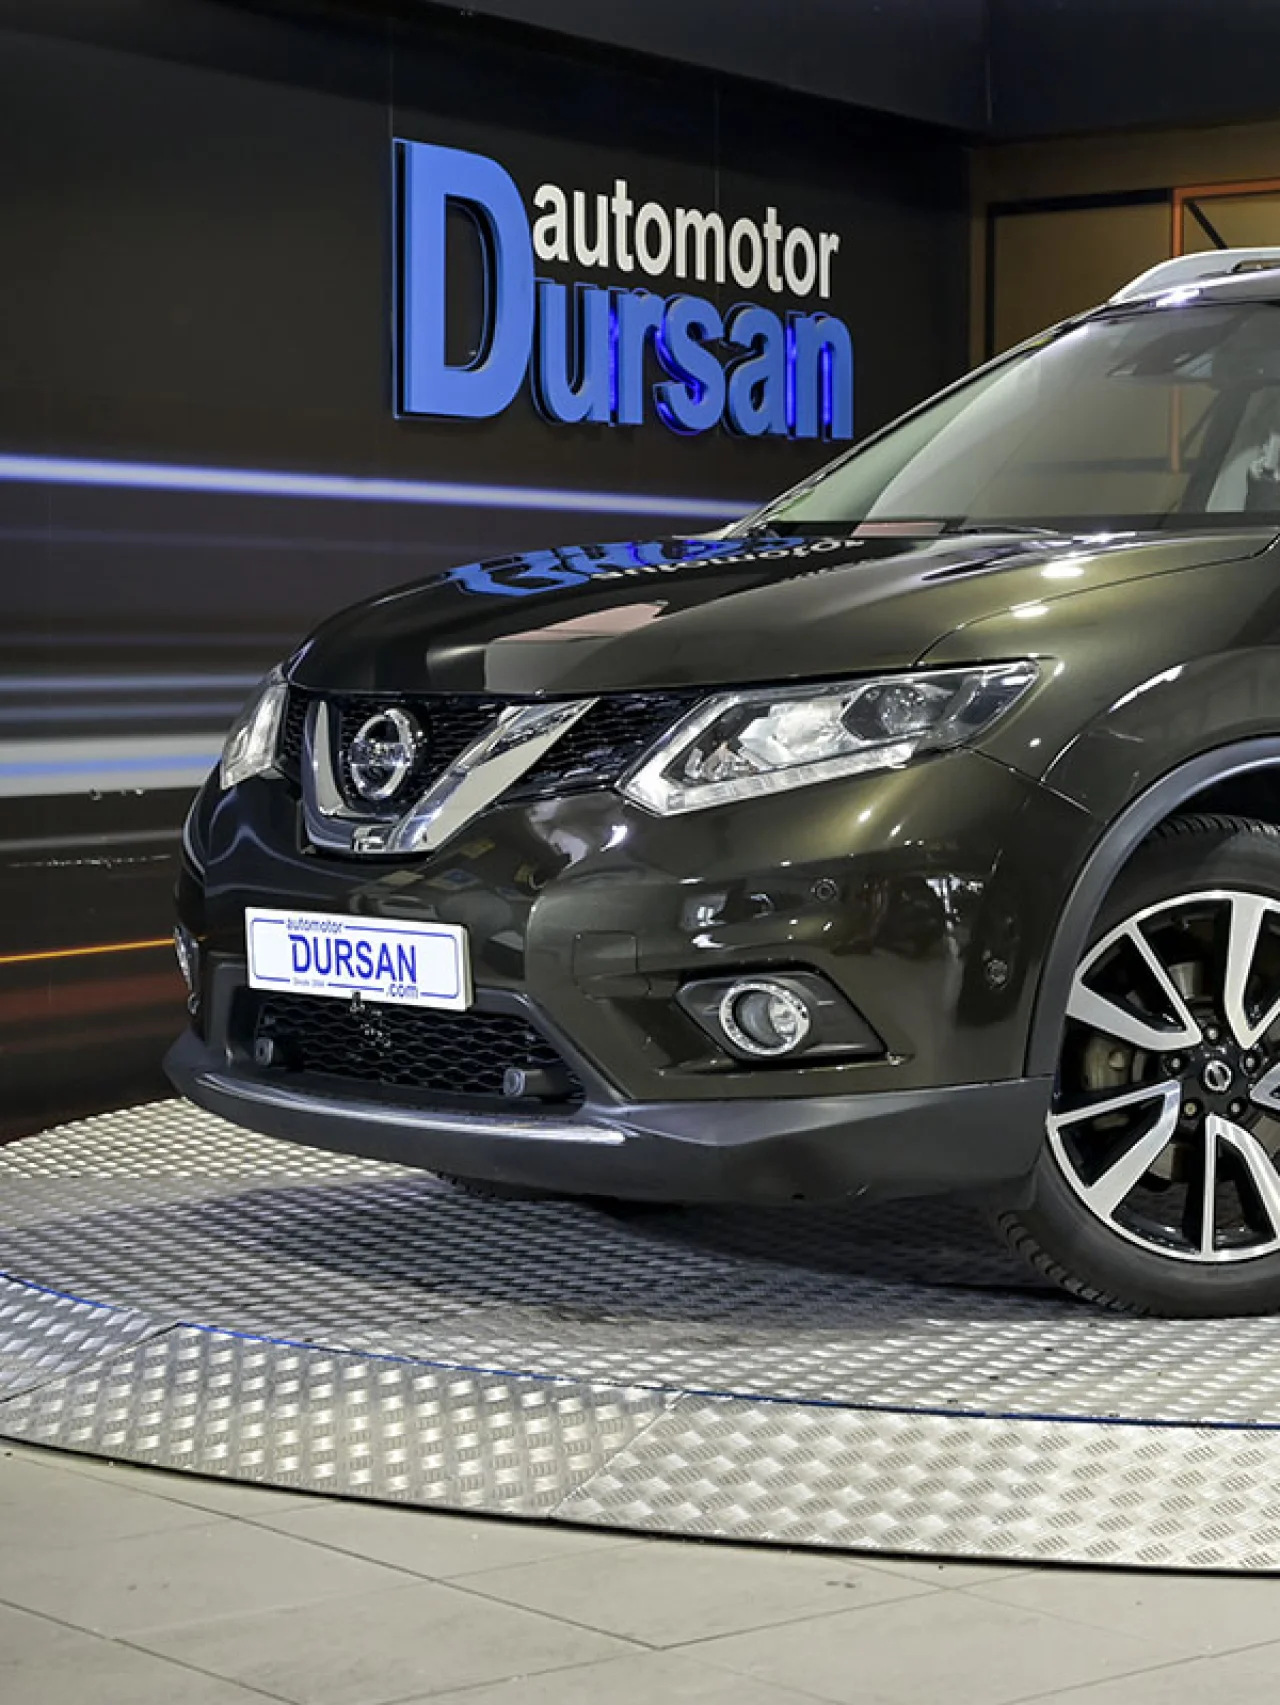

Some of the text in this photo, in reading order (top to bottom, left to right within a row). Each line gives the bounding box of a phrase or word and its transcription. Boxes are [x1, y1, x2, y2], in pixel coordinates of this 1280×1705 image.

[533, 179, 840, 298] automotor
[393, 138, 853, 440] Dursan
[287, 918, 344, 933] automotor
[289, 934, 417, 983] DURSAN
[386, 984, 419, 999] .com
